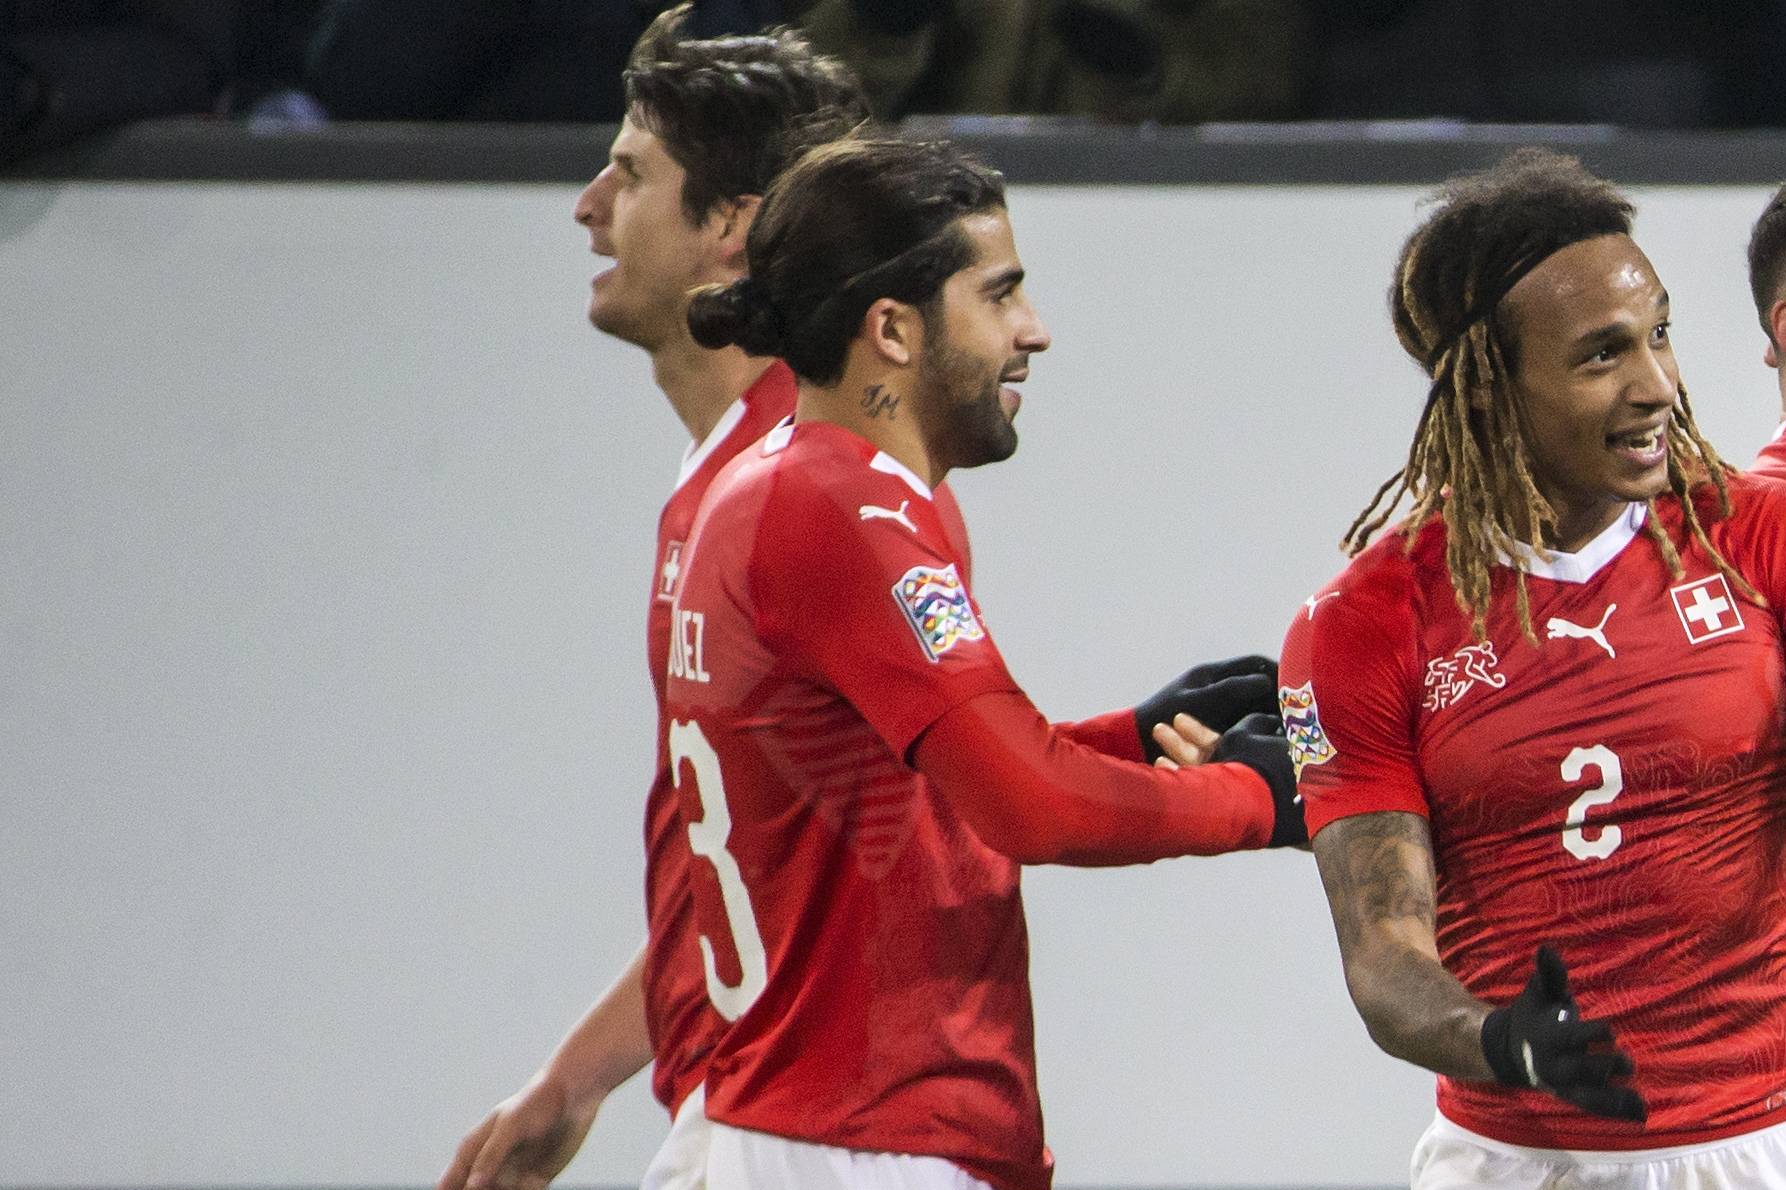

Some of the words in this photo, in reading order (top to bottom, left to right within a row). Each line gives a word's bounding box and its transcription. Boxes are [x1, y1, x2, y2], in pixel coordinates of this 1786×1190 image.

[668, 610, 710, 682] UEZ
[1560, 744, 1623, 860] 2
[669, 718, 767, 1022] 3
